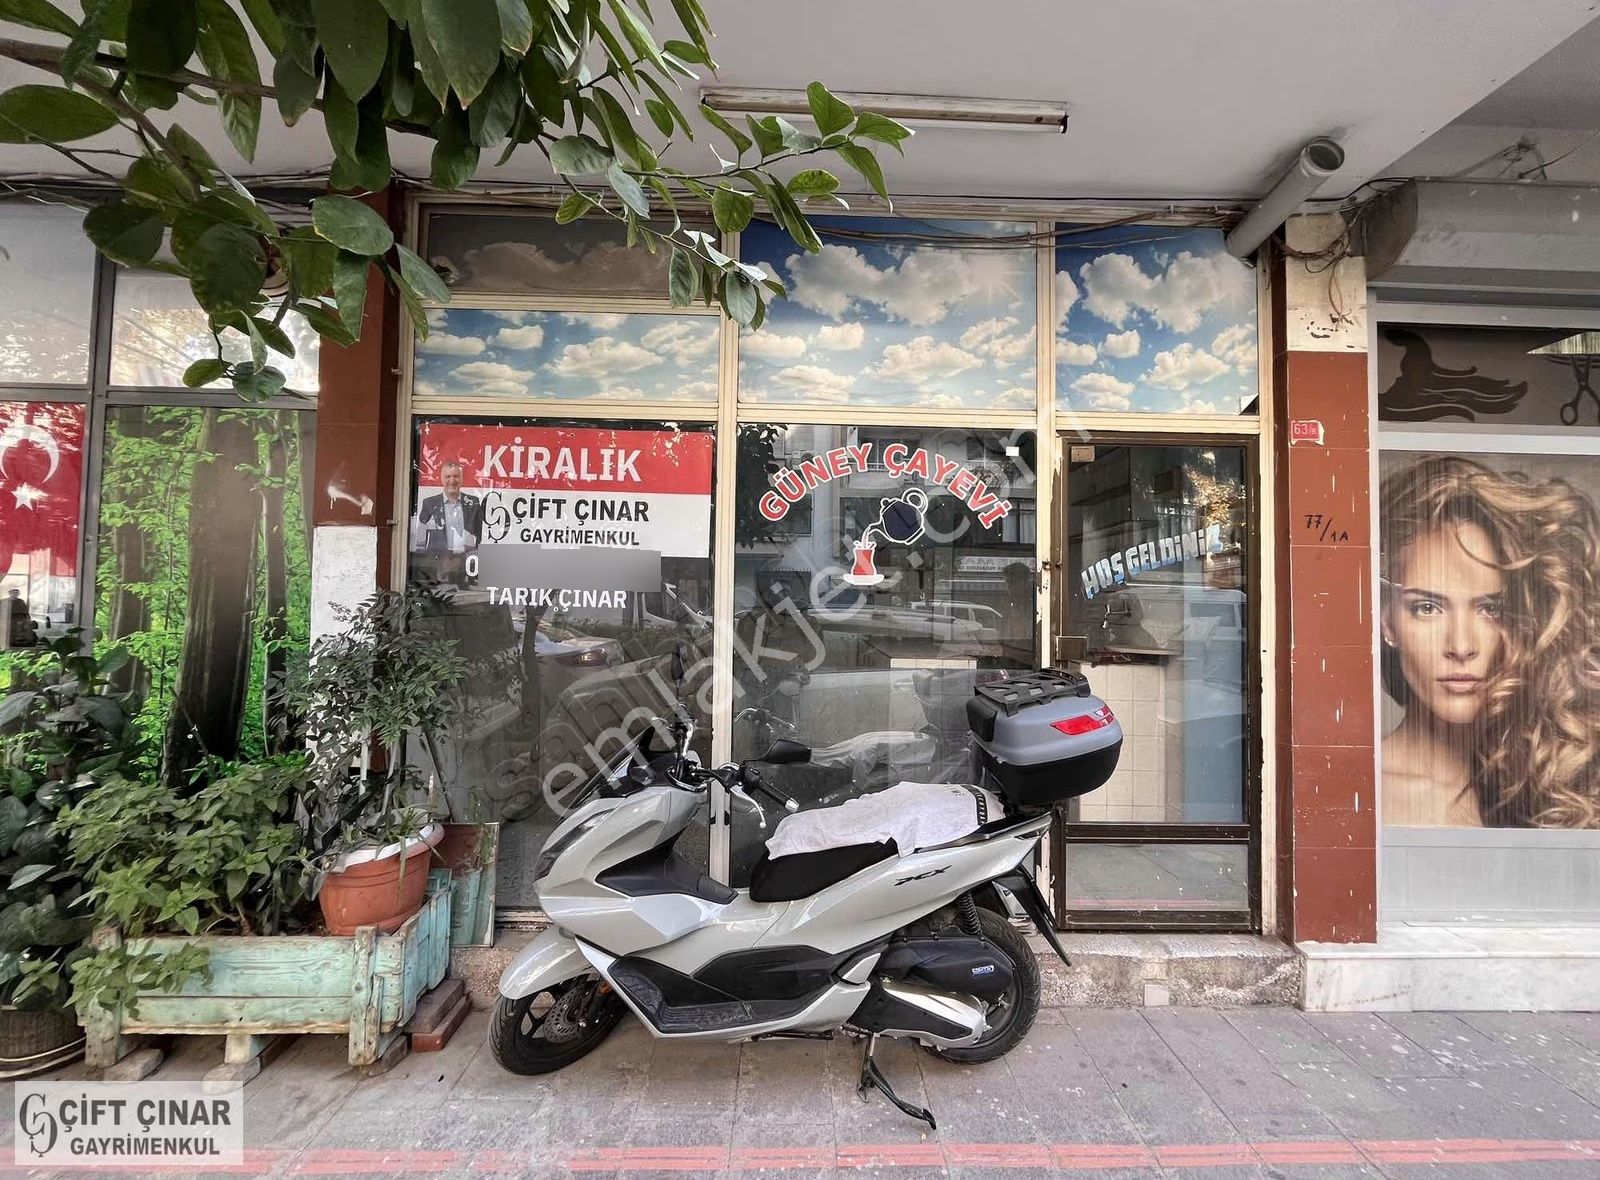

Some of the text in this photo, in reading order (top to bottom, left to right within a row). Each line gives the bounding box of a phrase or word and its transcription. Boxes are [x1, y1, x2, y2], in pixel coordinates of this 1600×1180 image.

[482, 436, 642, 482] KİRALIK
[758, 442, 1014, 530] GÜNEY ÇAYEVİ
[512, 492, 650, 525] ÇİFT ÇINAR
[519, 527, 641, 546] GAYRİMENKUL
[1081, 552, 1126, 600] HOŞ
[487, 585, 628, 611] TARIK ÇINAR
